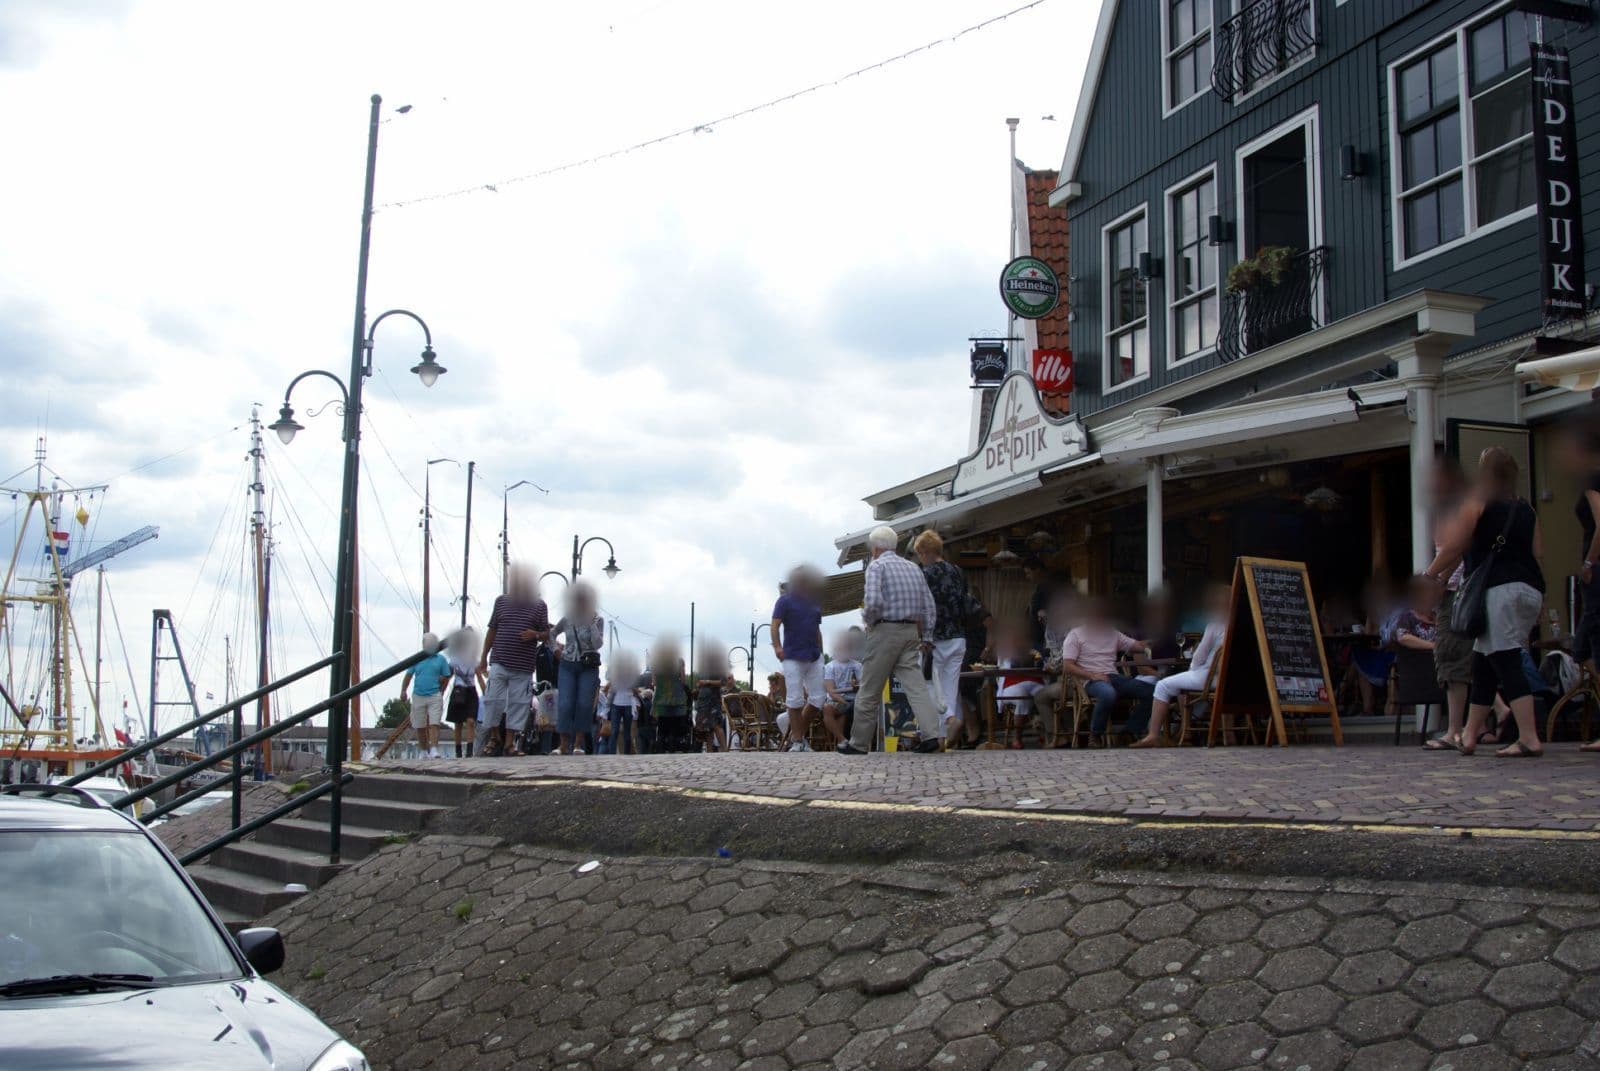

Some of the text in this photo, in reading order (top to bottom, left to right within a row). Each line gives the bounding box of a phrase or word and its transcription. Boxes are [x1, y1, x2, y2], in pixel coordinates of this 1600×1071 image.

[1543, 98, 1576, 292] DE DIJK
[1010, 279, 1054, 293] Heineken
[1036, 355, 1071, 387] illy
[986, 426, 1048, 470] DE DIJK
